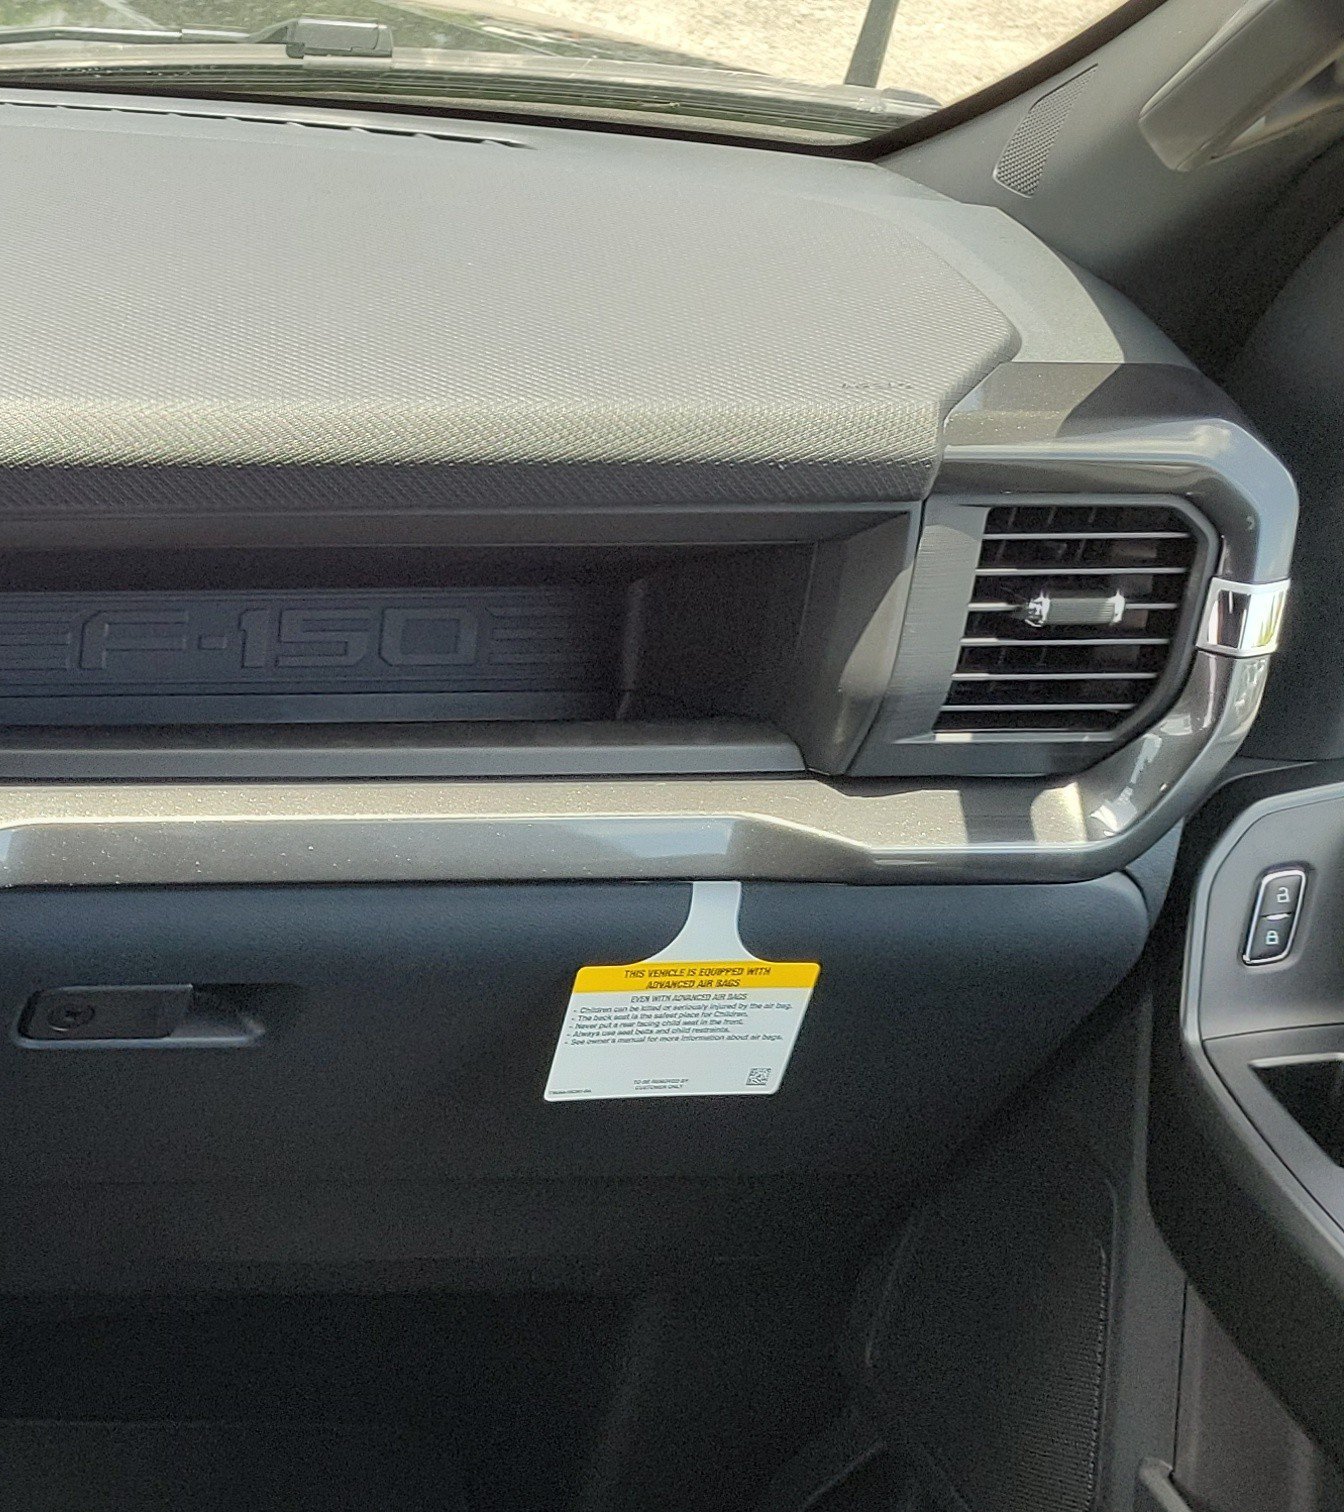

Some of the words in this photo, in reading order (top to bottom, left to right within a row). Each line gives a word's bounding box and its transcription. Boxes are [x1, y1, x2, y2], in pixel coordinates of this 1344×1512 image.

[77, 607, 478, 669] F-150
[625, 970, 645, 979] THIS
[648, 969, 685, 977] VEHICLE
[687, 968, 696, 976] IS
[699, 967, 744, 976] EQUIPPED
[747, 967, 771, 975] WITH
[646, 980, 695, 989] ADVANCED
[697, 979, 713, 988] AIR
[715, 979, 740, 987] BAGS
